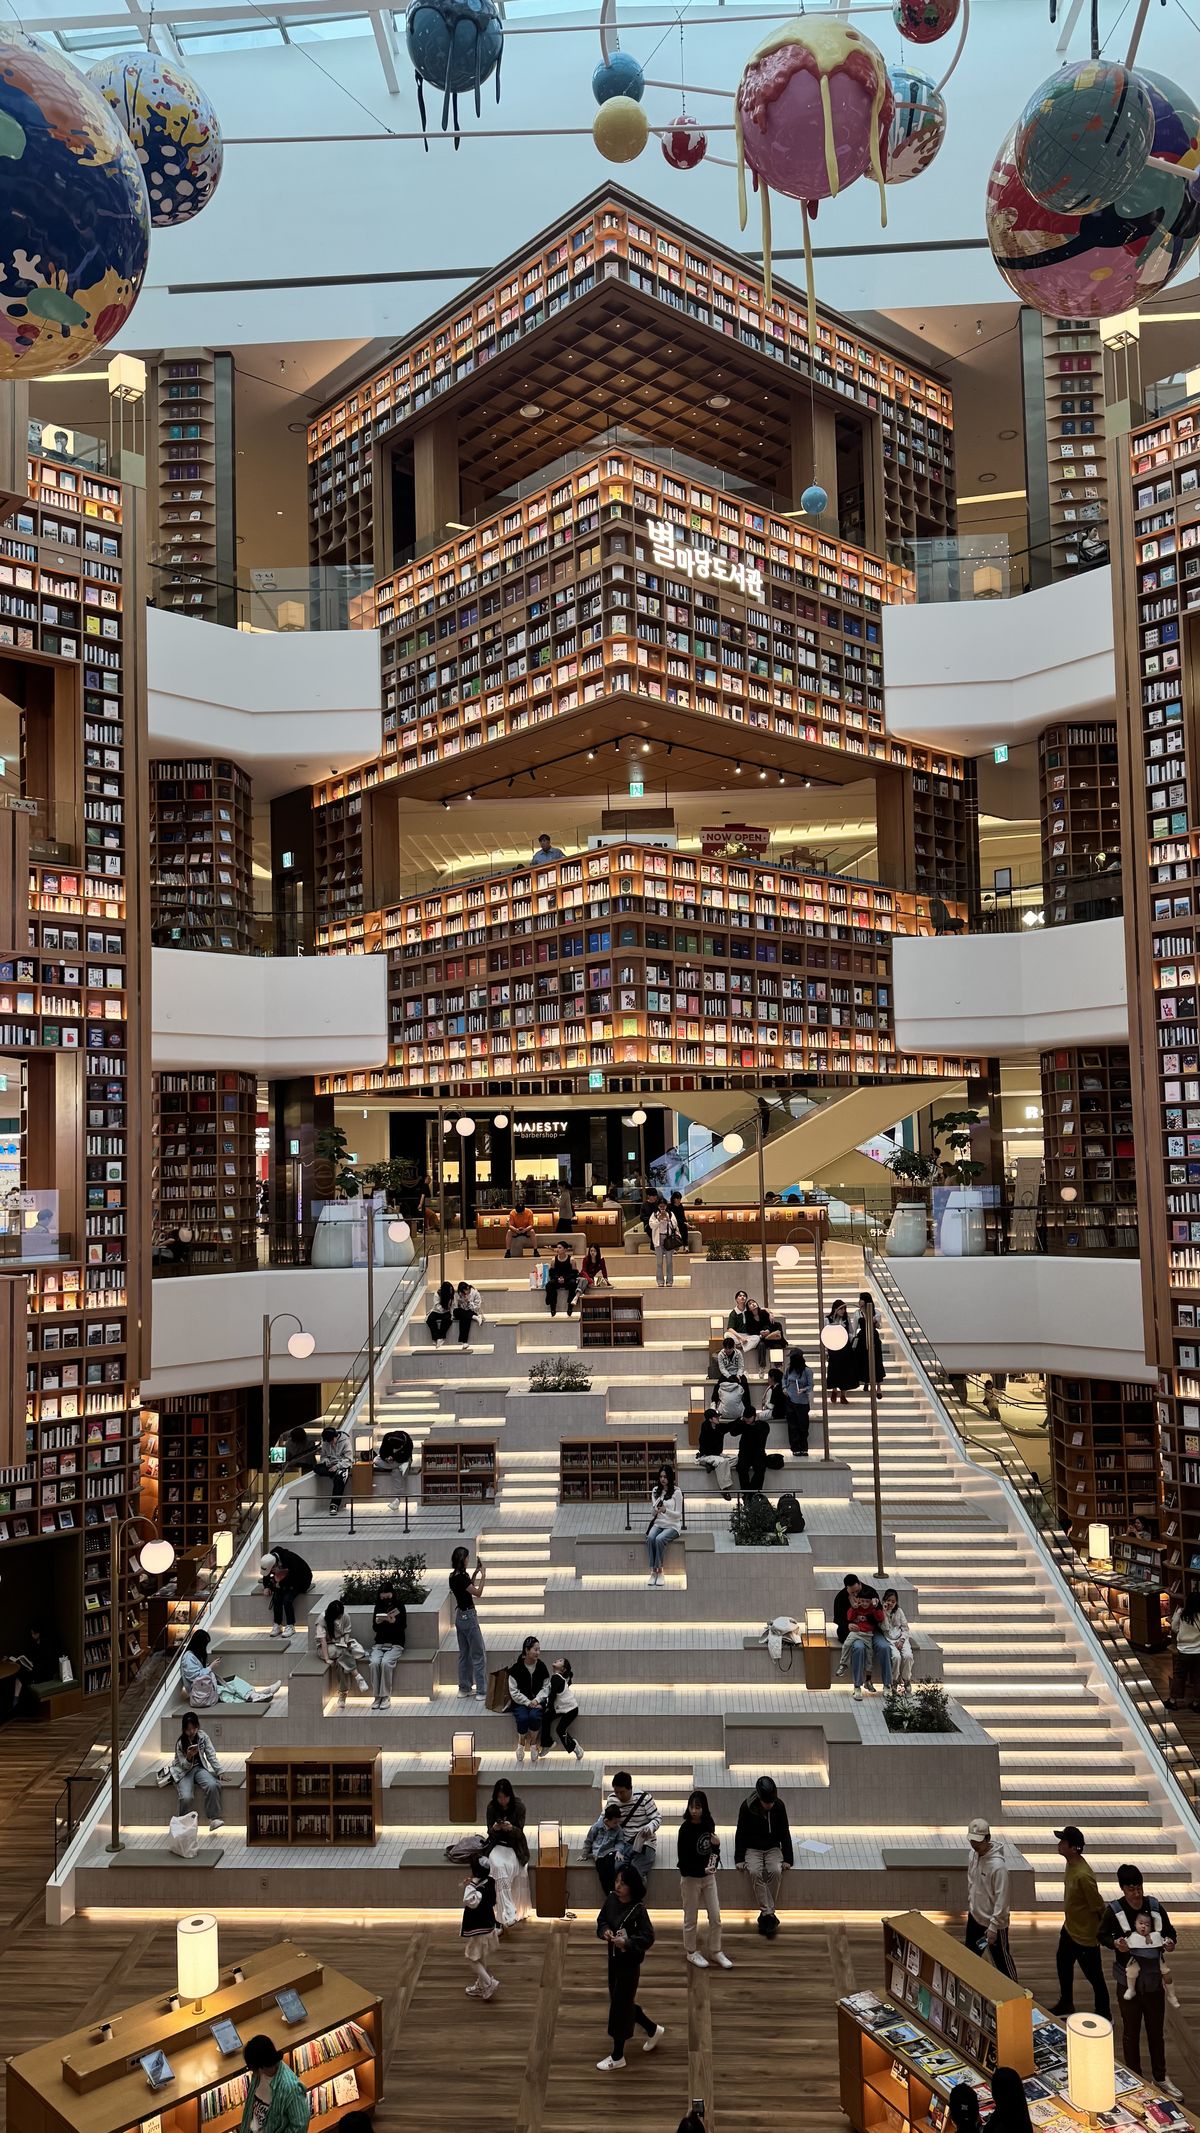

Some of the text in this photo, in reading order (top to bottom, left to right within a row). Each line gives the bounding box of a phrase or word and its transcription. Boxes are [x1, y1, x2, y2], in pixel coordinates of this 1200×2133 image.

[646, 519, 763, 597] 별마당도서관
[706, 833, 762, 842] NOW OPEN
[513, 1121, 568, 1132] MAJESTY
